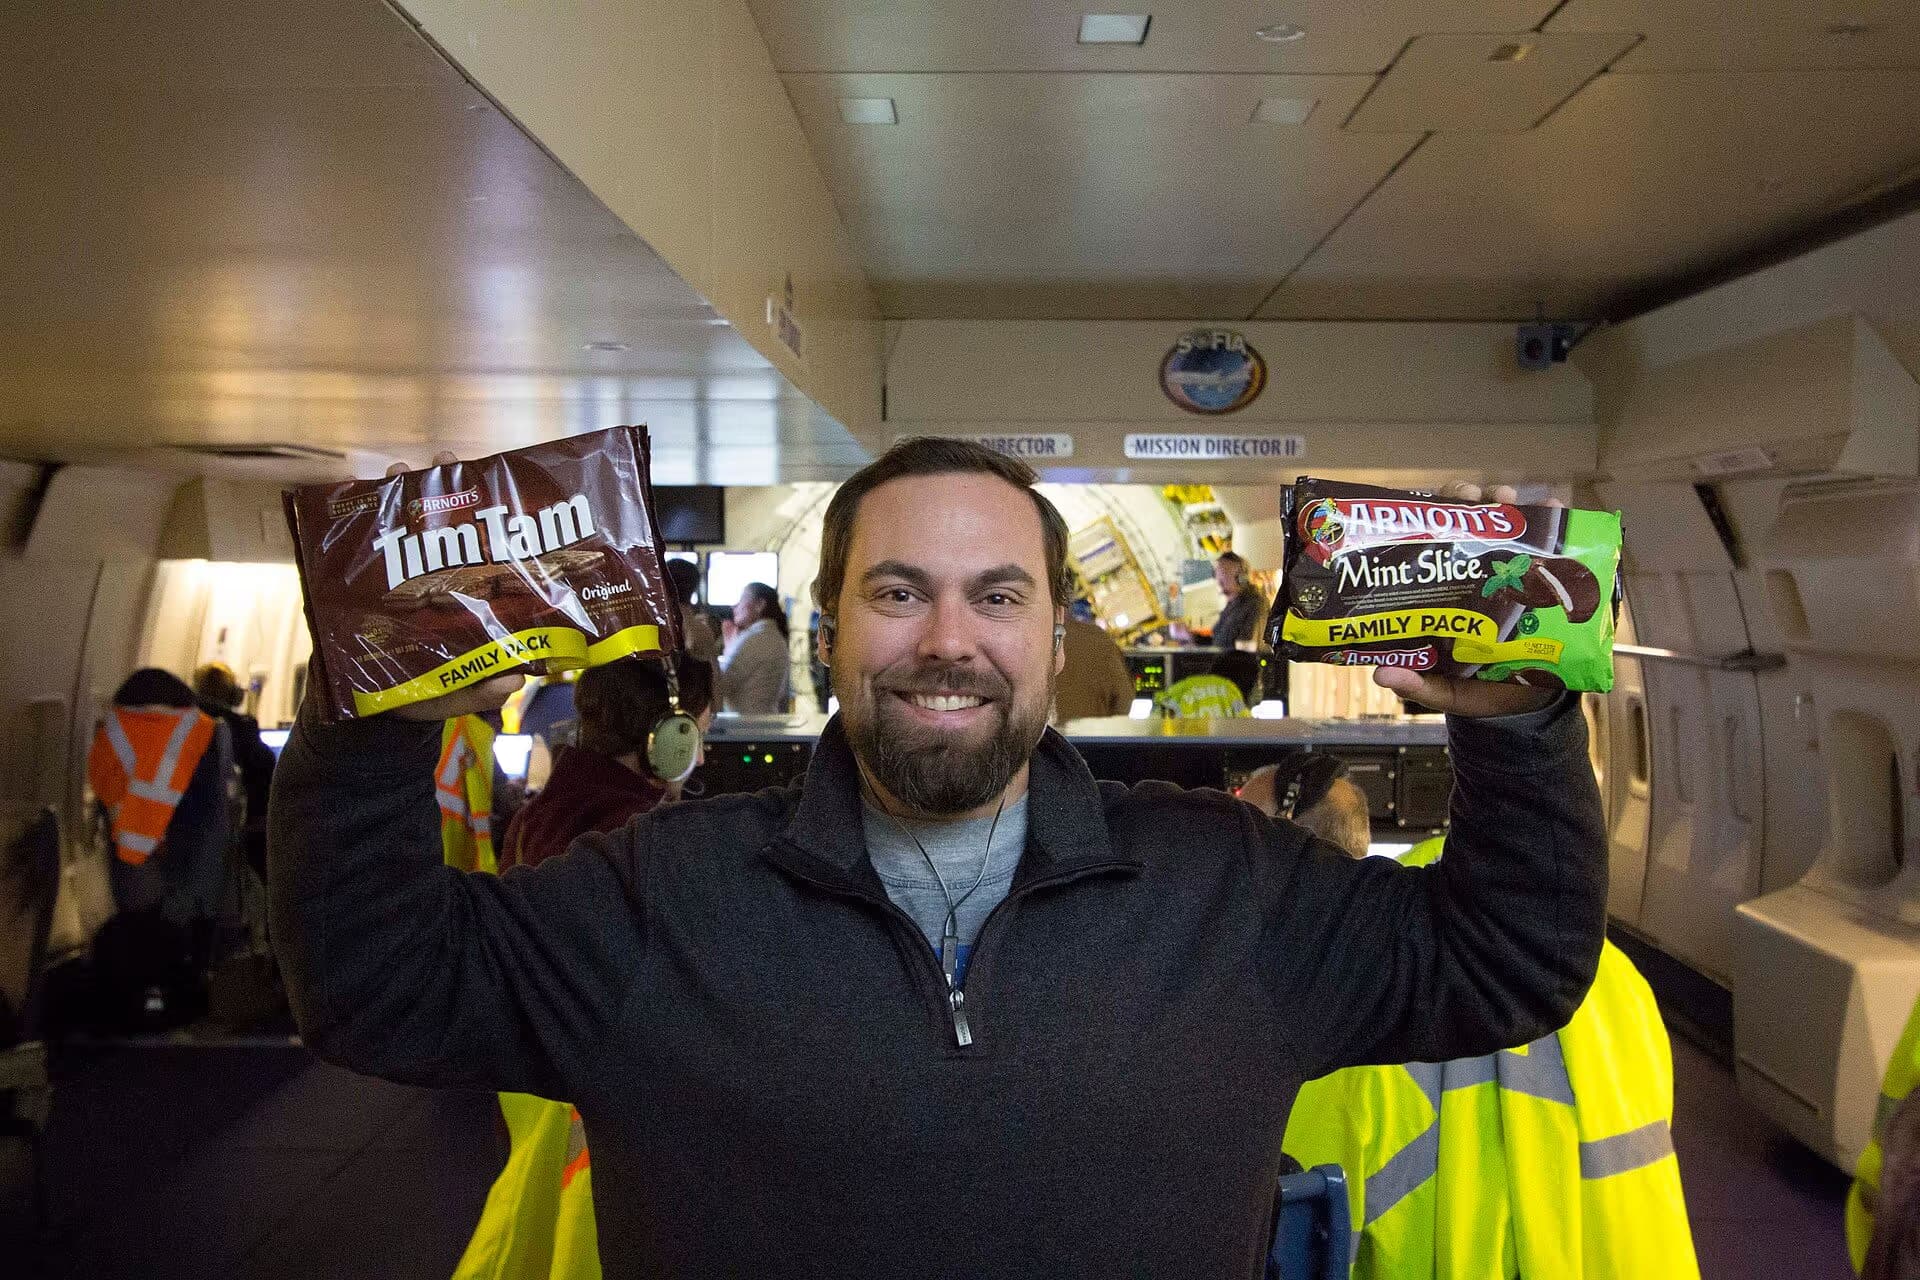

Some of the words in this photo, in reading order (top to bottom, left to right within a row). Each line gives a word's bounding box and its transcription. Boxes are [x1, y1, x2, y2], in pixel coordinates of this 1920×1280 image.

[980, 437, 1056, 455] DIRECTOR
[1134, 438, 1201, 455] MISSION
[1205, 438, 1279, 457] DIRECTOR
[1281, 439, 1296, 457] II
[423, 490, 479, 512] ARNOTT'S
[1347, 504, 1514, 534] ARNOTT'S
[1337, 554, 1411, 593] Mint
[1417, 550, 1483, 584] Slice
[581, 578, 633, 601] Original
[1328, 616, 1412, 642] FAMILY
[1420, 614, 1484, 637] PACK
[438, 648, 500, 688] FAMILY
[505, 634, 552, 658] PACK
[1346, 650, 1429, 666] ARNOTT'S
